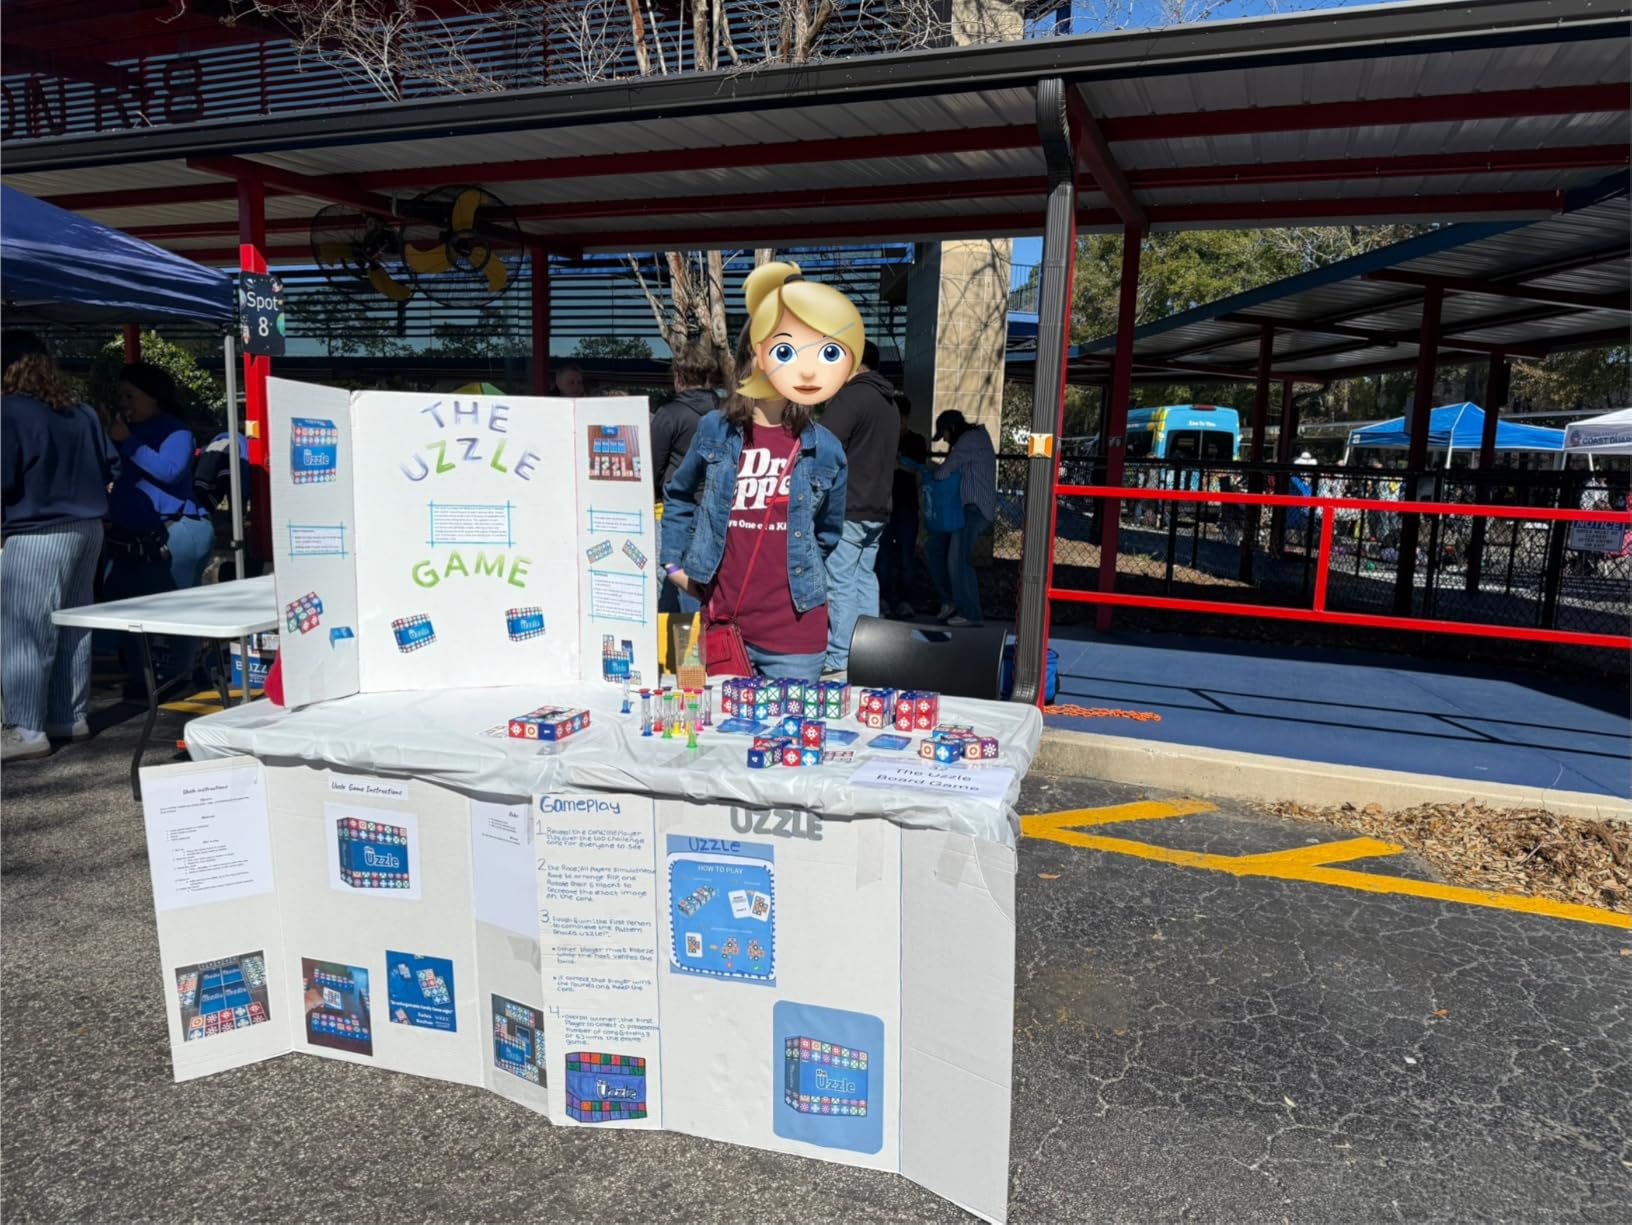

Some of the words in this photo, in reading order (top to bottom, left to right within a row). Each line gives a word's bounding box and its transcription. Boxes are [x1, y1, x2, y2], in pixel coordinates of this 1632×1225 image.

[246, 291, 279, 312] Spot
[258, 317, 269, 337] 8
[420, 400, 511, 433] THE
[399, 437, 542, 482] UZZLE
[737, 448, 788, 477] Dr
[739, 520, 756, 529] One
[411, 550, 534, 588] GAME
[896, 768, 923, 776] The
[876, 774, 926, 785] Board
[929, 780, 980, 792] Game
[730, 807, 824, 841] UZZLE
[364, 851, 400, 869] Uzzle
[726, 867, 744, 875] PLAY
[816, 1074, 856, 1094] Uzzle
